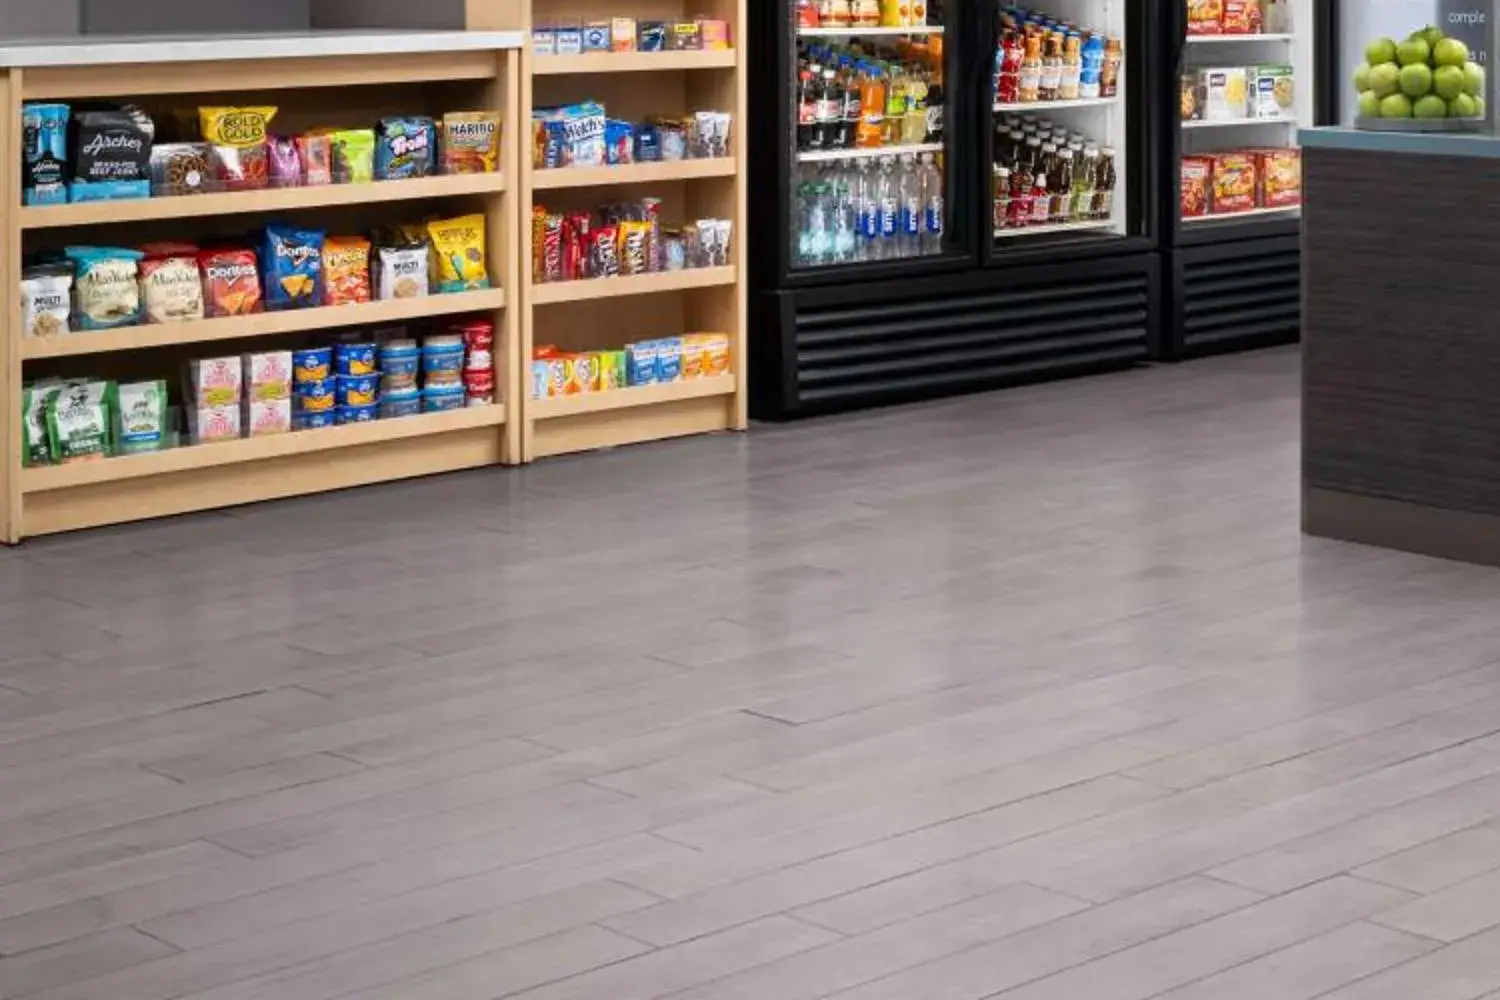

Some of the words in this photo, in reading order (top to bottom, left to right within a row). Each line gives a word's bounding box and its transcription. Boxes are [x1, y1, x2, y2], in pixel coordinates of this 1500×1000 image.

[450, 123, 495, 135] HARIBO
[83, 133, 142, 156] Archer
[207, 264, 257, 279] Doritos
